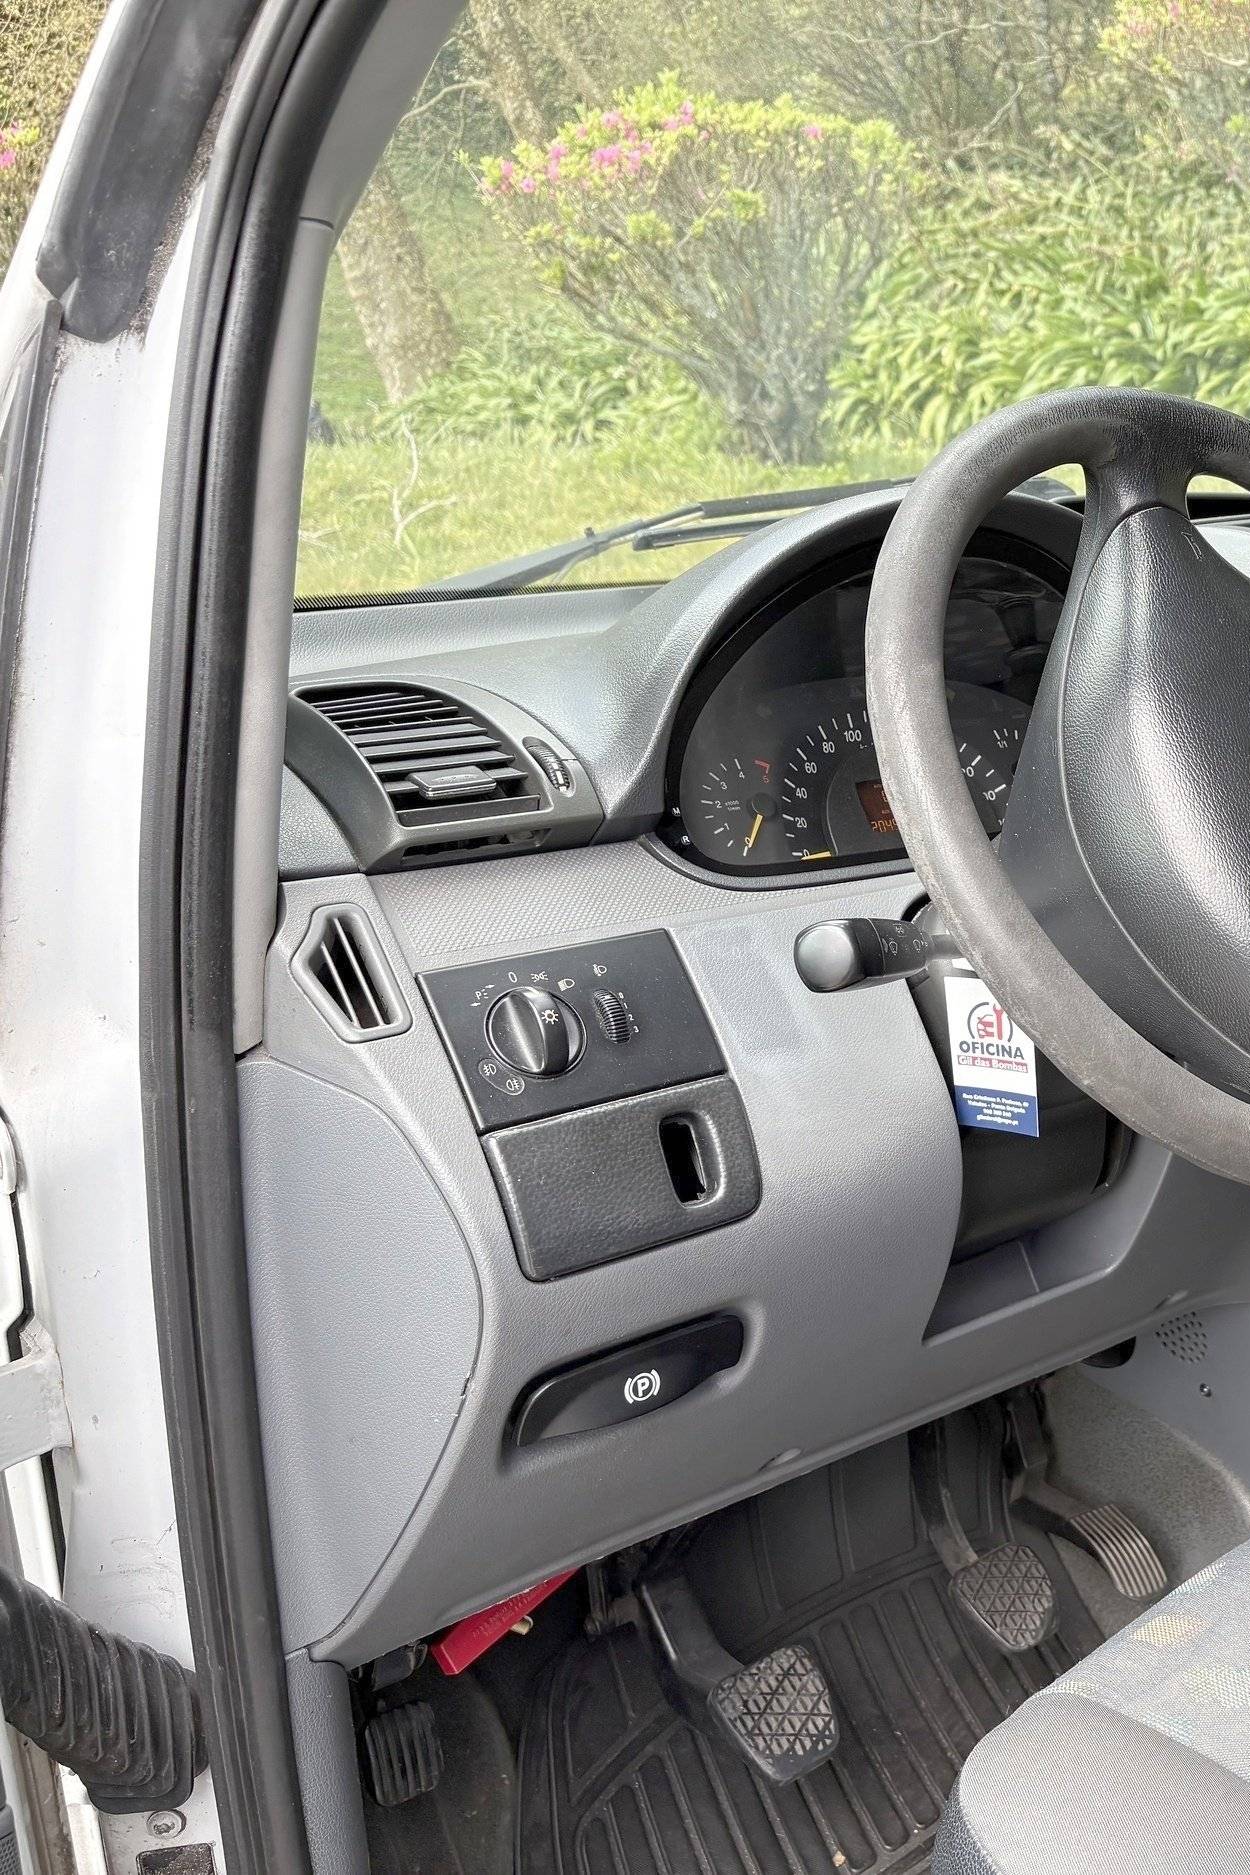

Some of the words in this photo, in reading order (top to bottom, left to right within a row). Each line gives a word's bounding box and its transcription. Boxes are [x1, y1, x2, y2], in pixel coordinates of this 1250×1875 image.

[844, 730, 862, 743] 100
[822, 741, 835, 754] 80
[805, 762, 817, 774] 60
[738, 771, 745, 780] 4
[720, 781, 728, 790] 3
[795, 787, 808, 799] 40
[715, 800, 722, 809] 2
[723, 823, 730, 831] 1
[795, 817, 808, 829] 20
[508, 971, 518, 983] 0
[629, 1014, 634, 1022] 2
[633, 1025, 640, 1034] 3
[959, 1040, 1025, 1060] OFICINA
[637, 1377, 650, 1398] P
